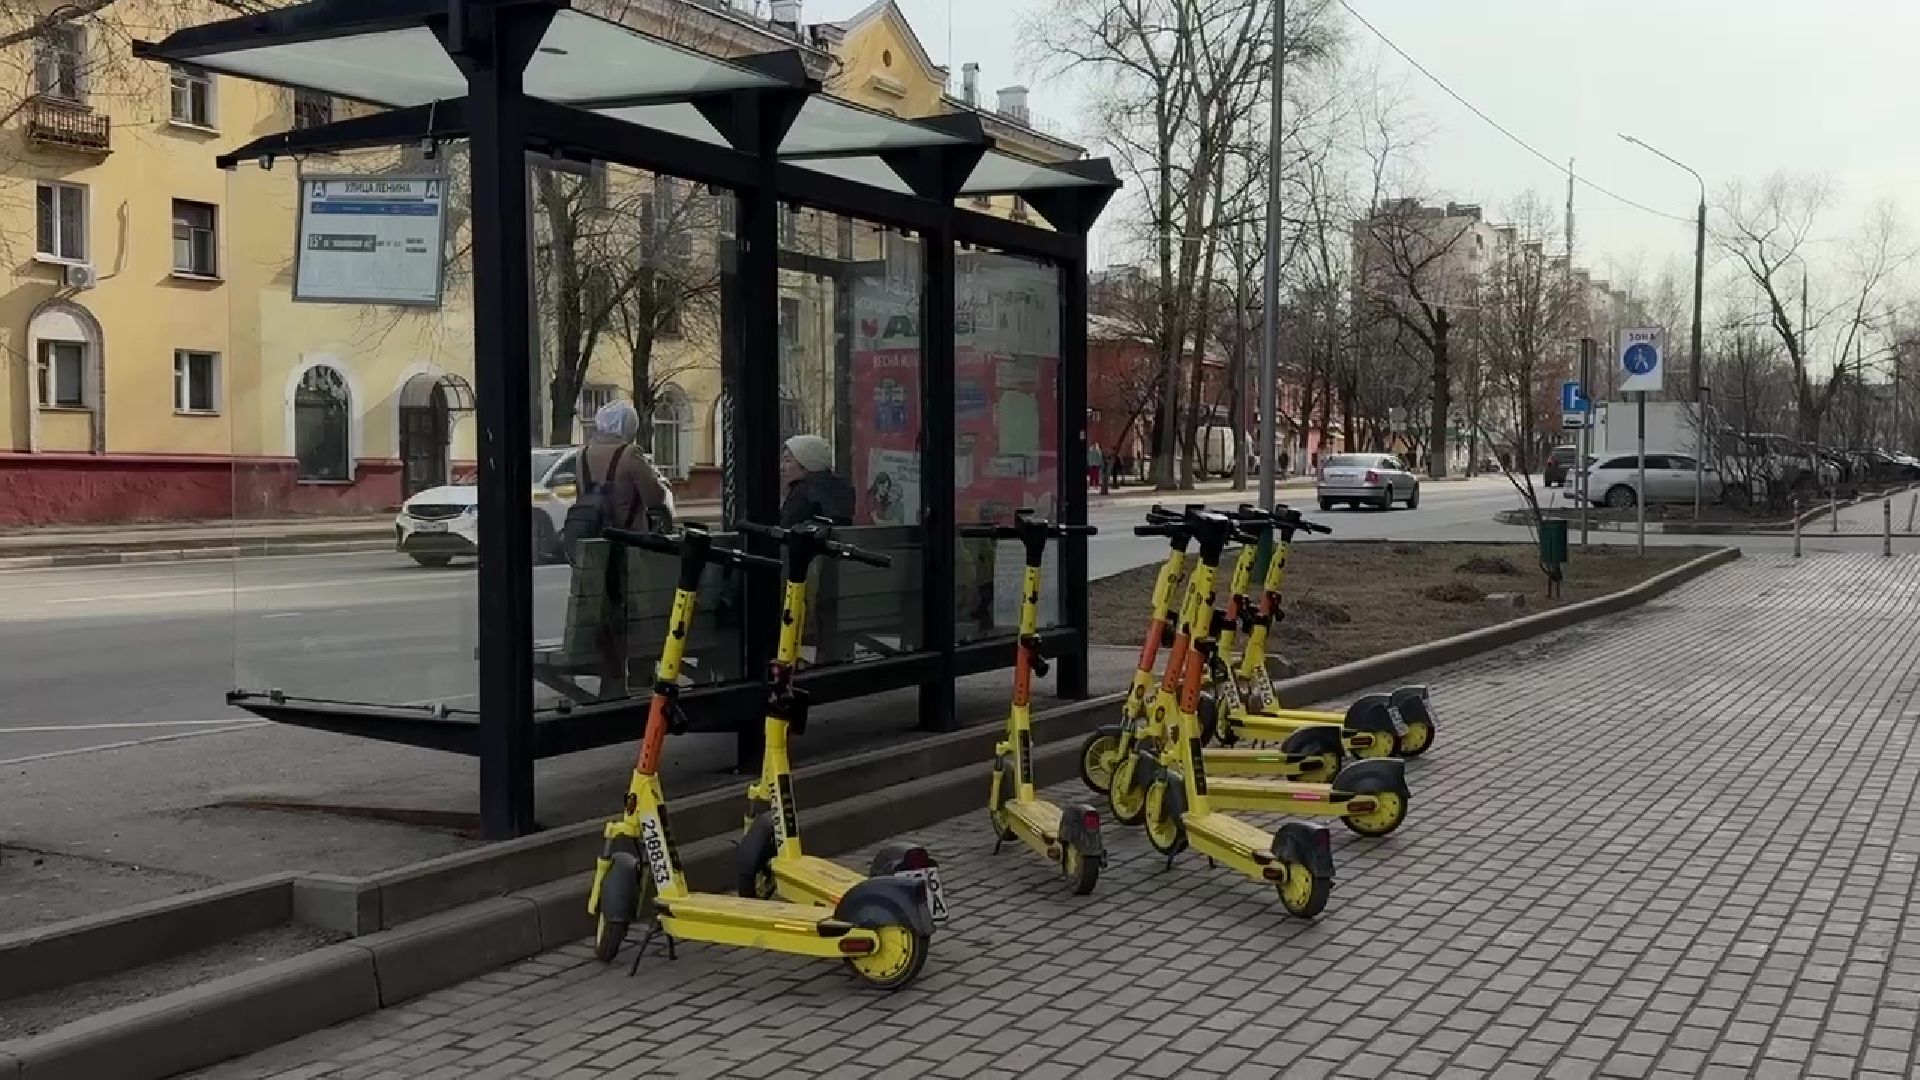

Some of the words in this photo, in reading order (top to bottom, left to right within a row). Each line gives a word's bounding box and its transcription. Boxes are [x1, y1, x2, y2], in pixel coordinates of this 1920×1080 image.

[345, 182, 373, 194] УЛИЦА
[374, 182, 412, 193] ЛЕНИНА
[1629, 333, 1656, 342] ЗОНА
[642, 819, 671, 884] 218833
